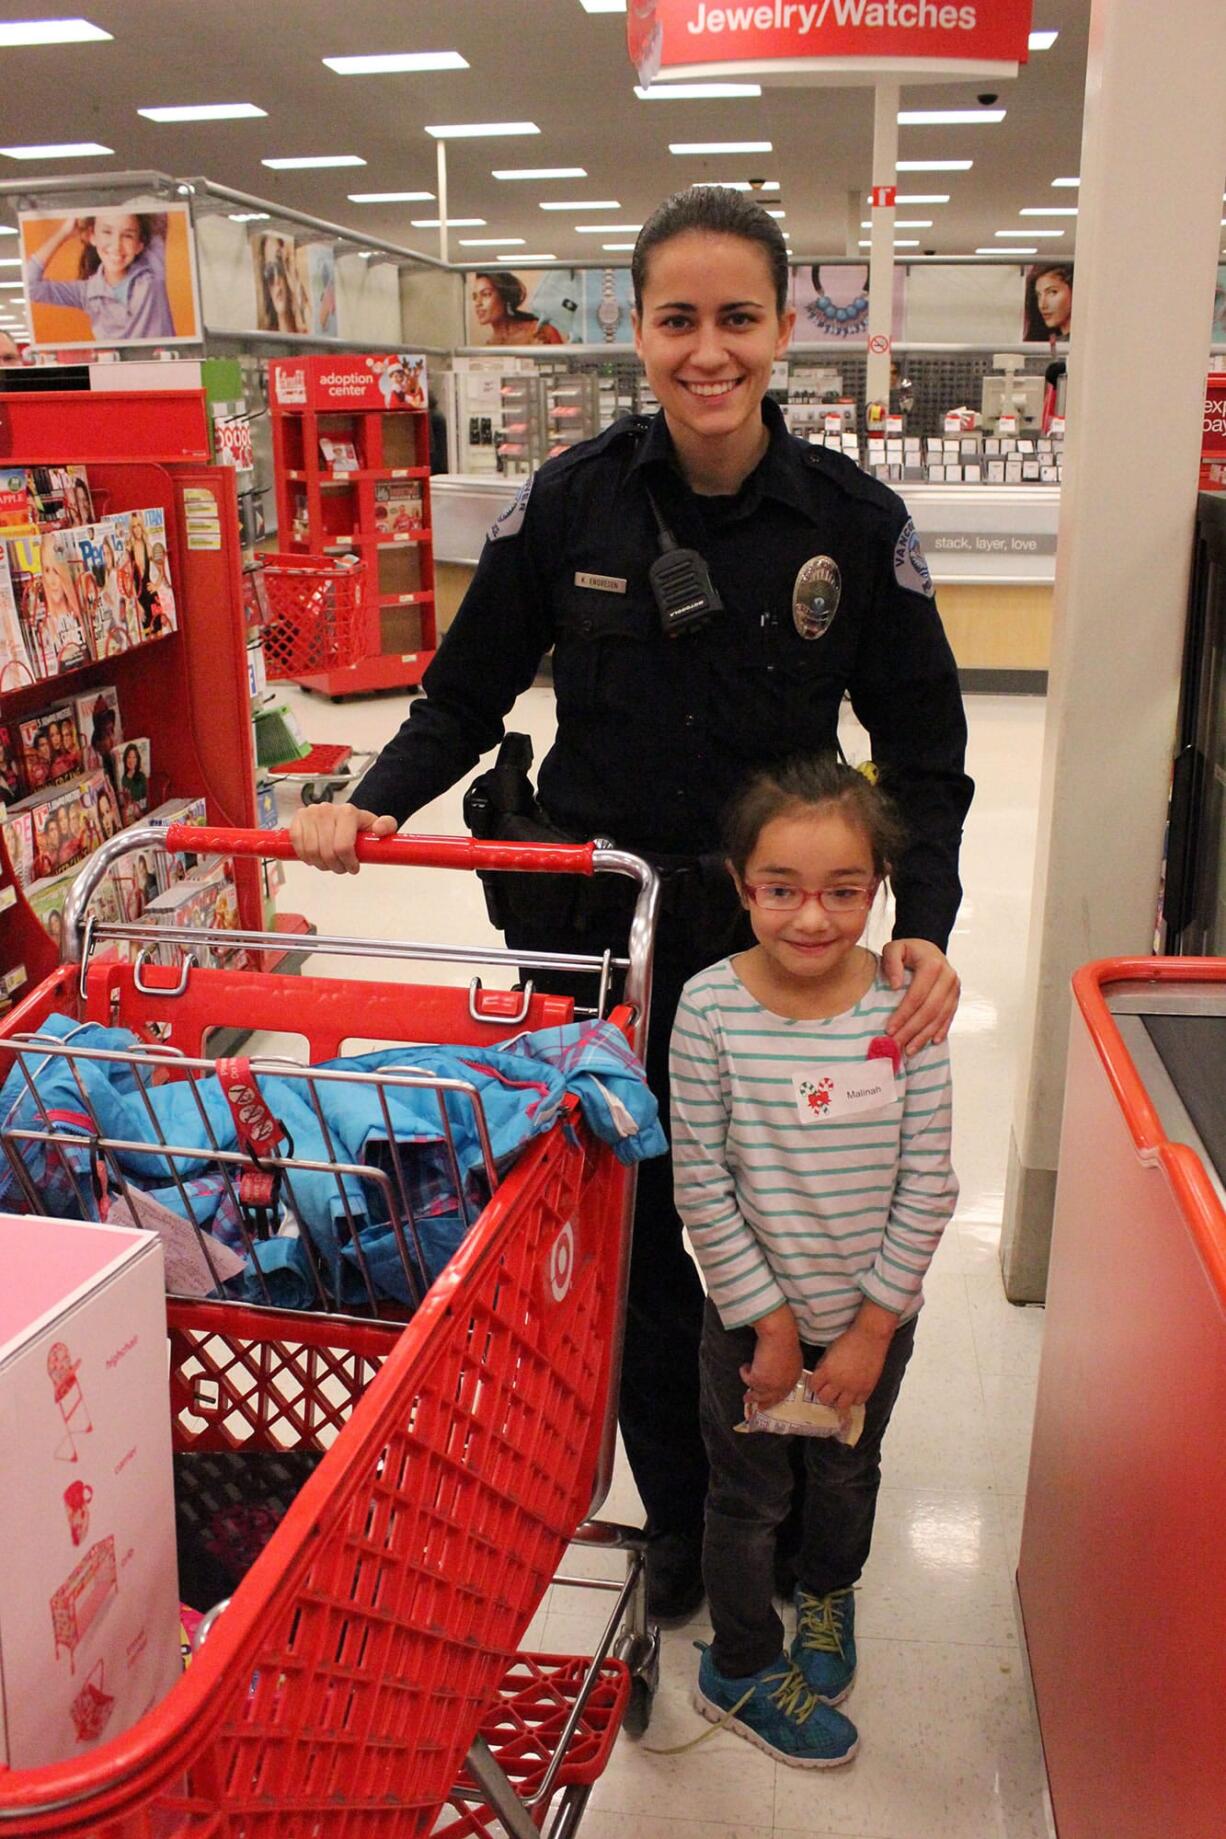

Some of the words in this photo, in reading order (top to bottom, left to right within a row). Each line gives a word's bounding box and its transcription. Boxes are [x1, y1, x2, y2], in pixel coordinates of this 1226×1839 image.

[687, 0, 977, 34] Jewelry/Watches
[319, 372, 373, 386] adoption
[328, 385, 367, 396] center
[975, 537, 1008, 551] layer,
[1011, 538, 1038, 550] love
